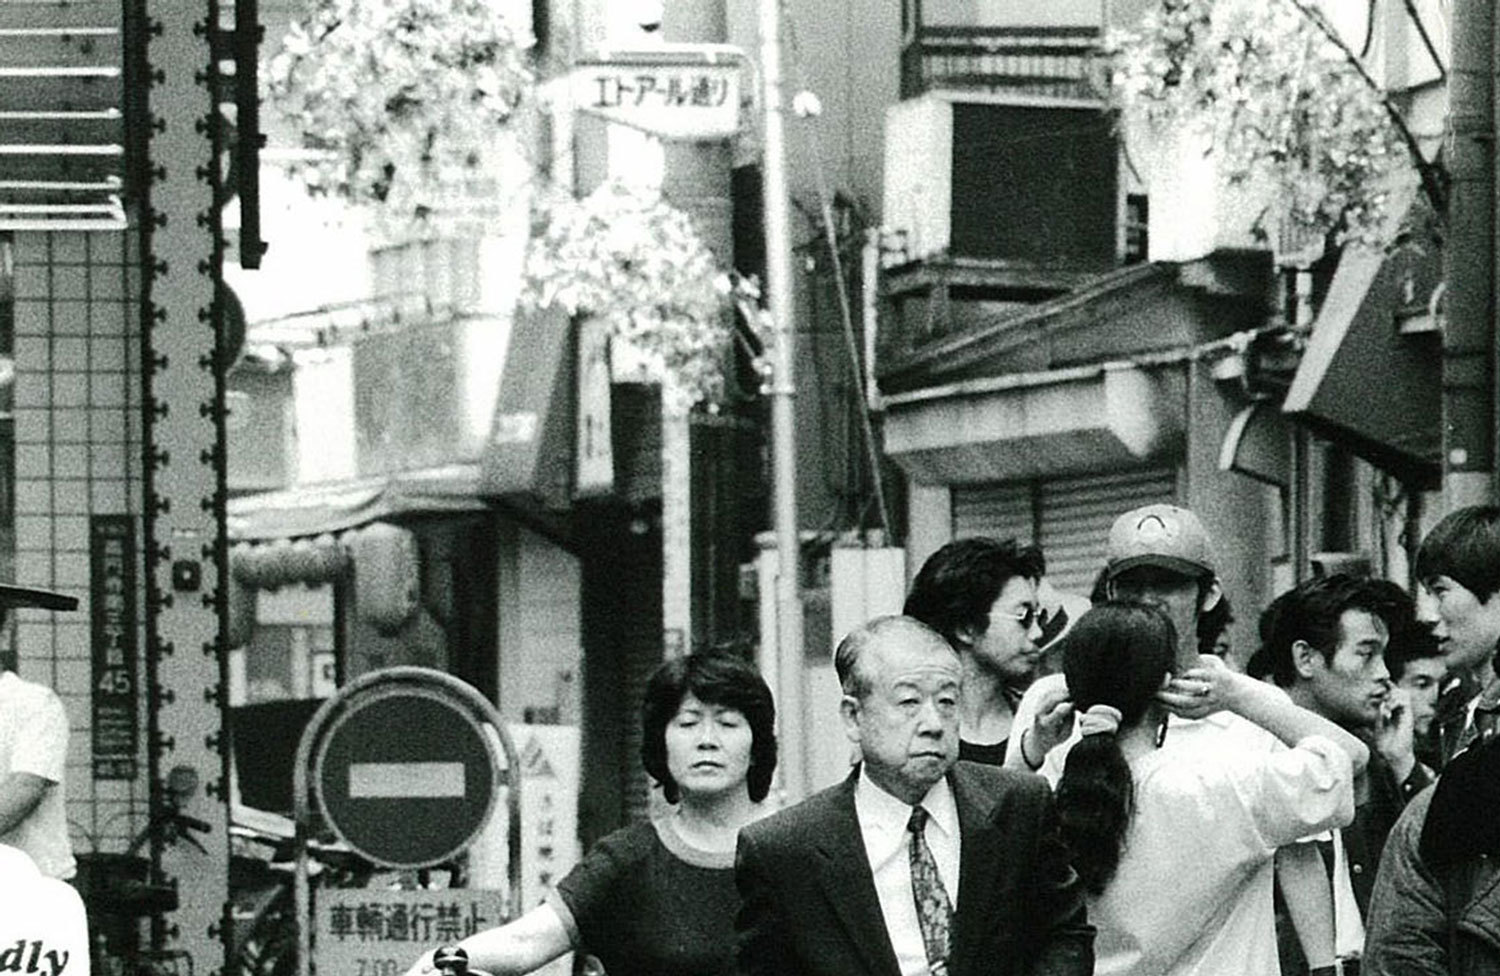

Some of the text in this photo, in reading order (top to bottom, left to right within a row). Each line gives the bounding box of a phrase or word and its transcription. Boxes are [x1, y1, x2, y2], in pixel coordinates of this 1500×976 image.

[592, 76, 728, 107] エトアール通り
[98, 670, 131, 695] 45
